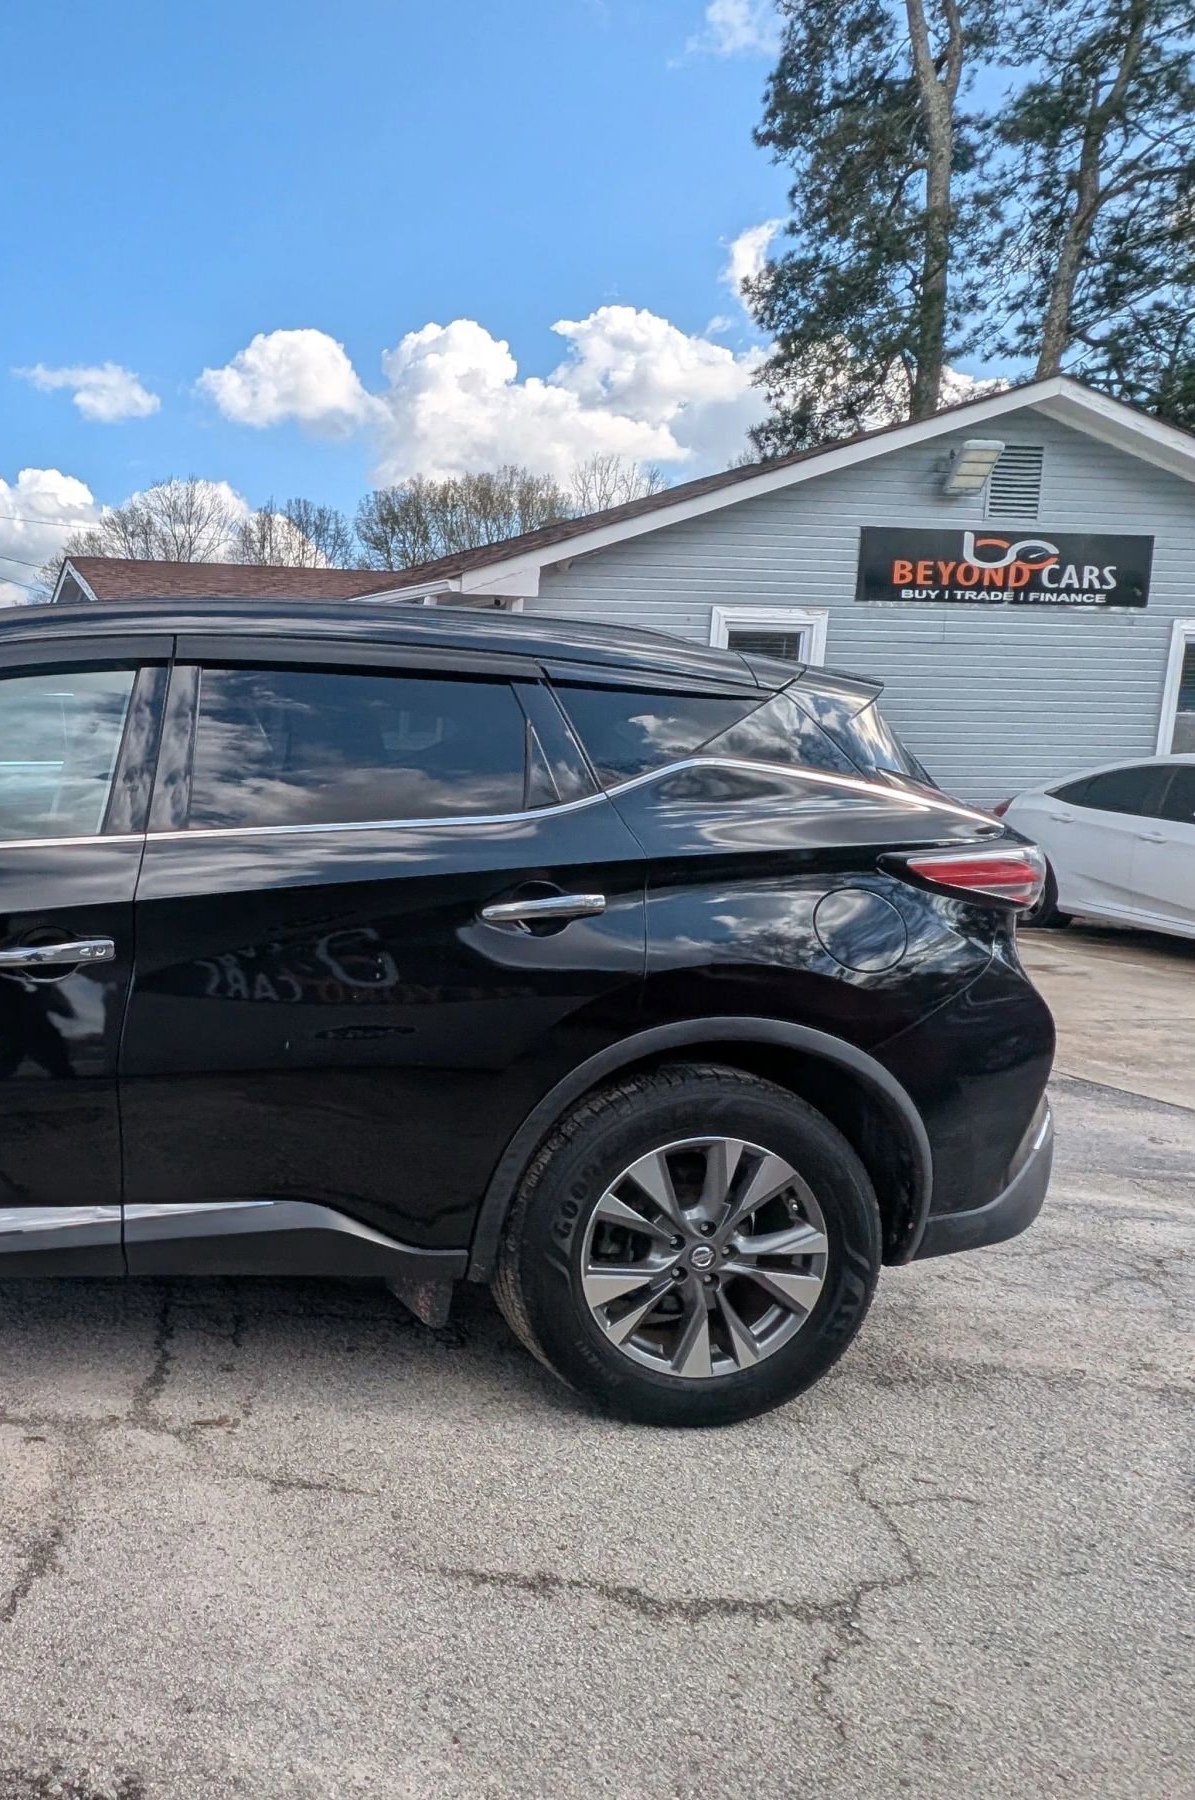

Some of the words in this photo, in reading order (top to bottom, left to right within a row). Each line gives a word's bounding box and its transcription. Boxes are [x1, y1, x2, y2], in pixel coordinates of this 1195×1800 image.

[892, 559, 1030, 588] BEYOND
[1041, 564, 1118, 590] CARS
[901, 588, 940, 600] BUY
[953, 590, 1014, 602] TRADE
[1029, 592, 1107, 604] FINANCE
